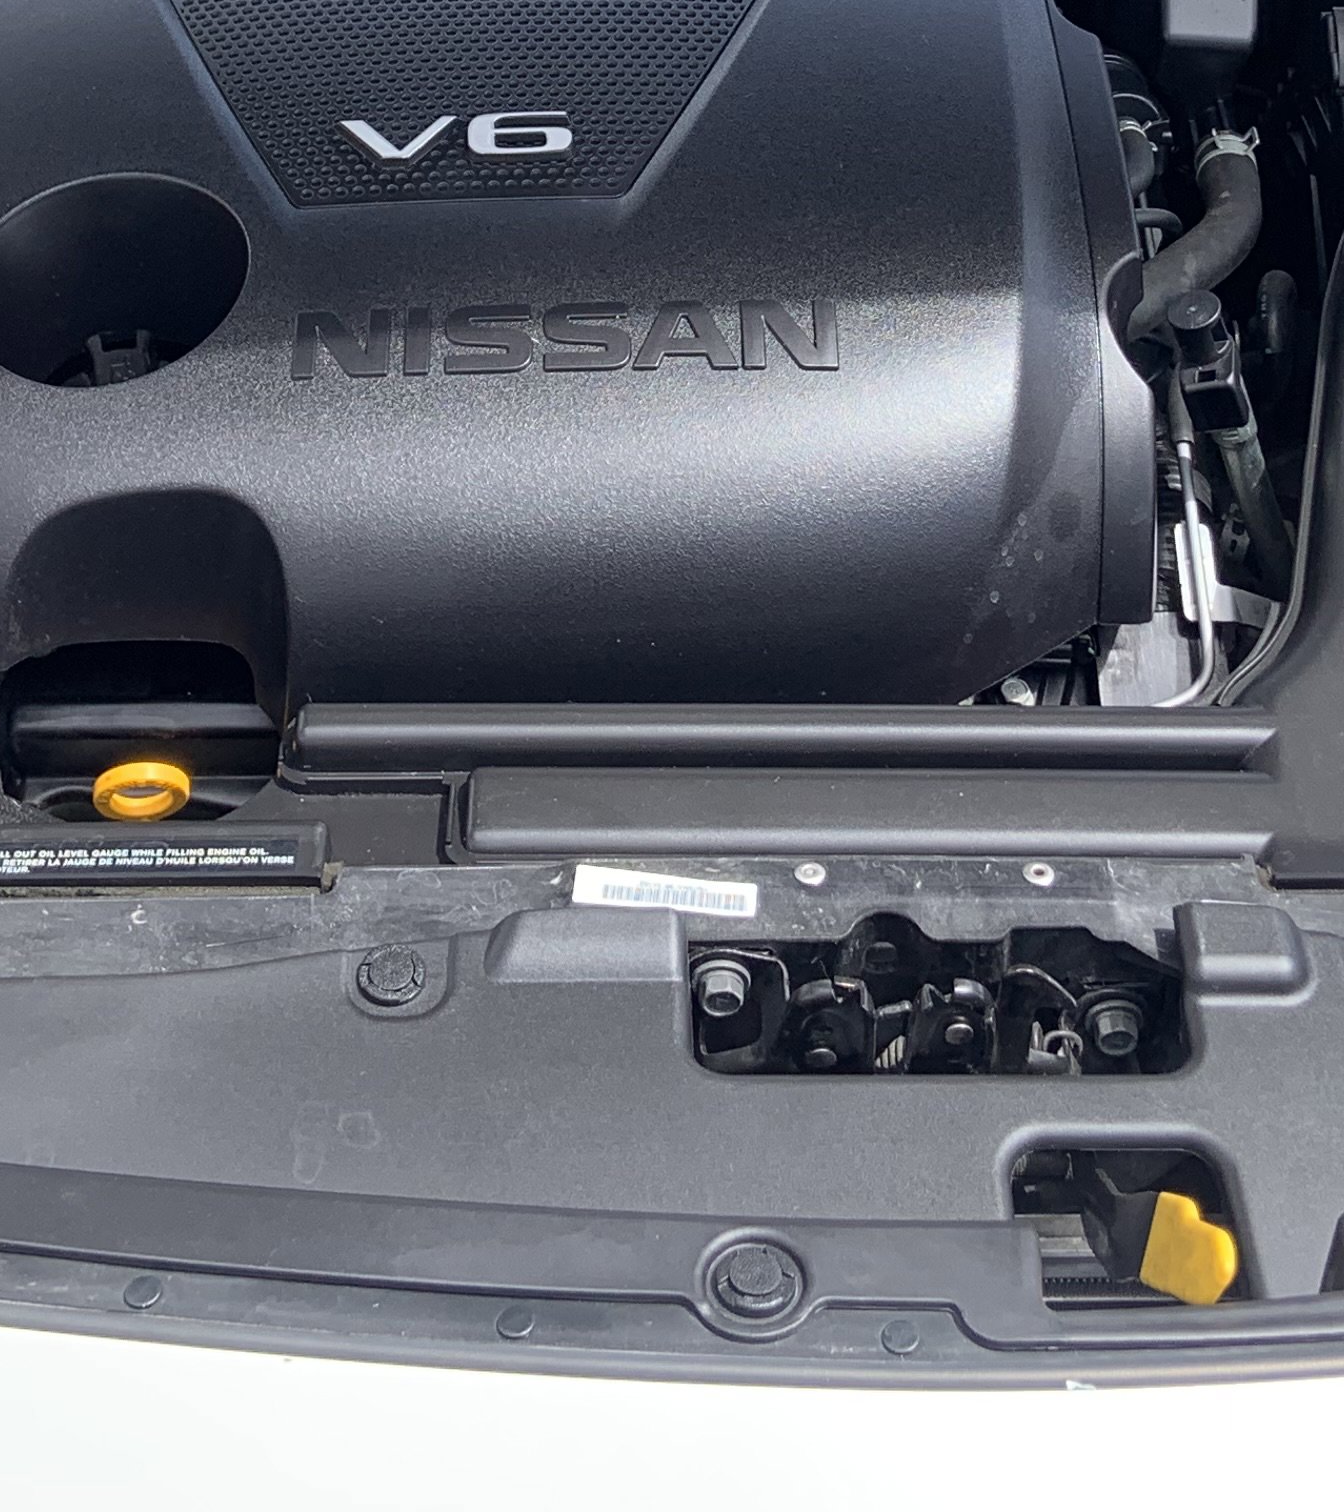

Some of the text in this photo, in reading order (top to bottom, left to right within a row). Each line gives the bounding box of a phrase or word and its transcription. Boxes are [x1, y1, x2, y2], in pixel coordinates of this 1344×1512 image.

[339, 110, 574, 168] V6
[291, 298, 838, 381] NISSAN
[14, 850, 36, 858] OUT
[38, 850, 55, 858] OIL
[166, 848, 205, 856] FILLING
[207, 848, 247, 856] ENGINE
[63, 858, 96, 866] JAUGE
[115, 857, 153, 865] NIVEAU
[156, 857, 196, 865] D'HUILE
[198, 856, 257, 864] LORSQU'ON
[261, 856, 295, 864] VERSE
